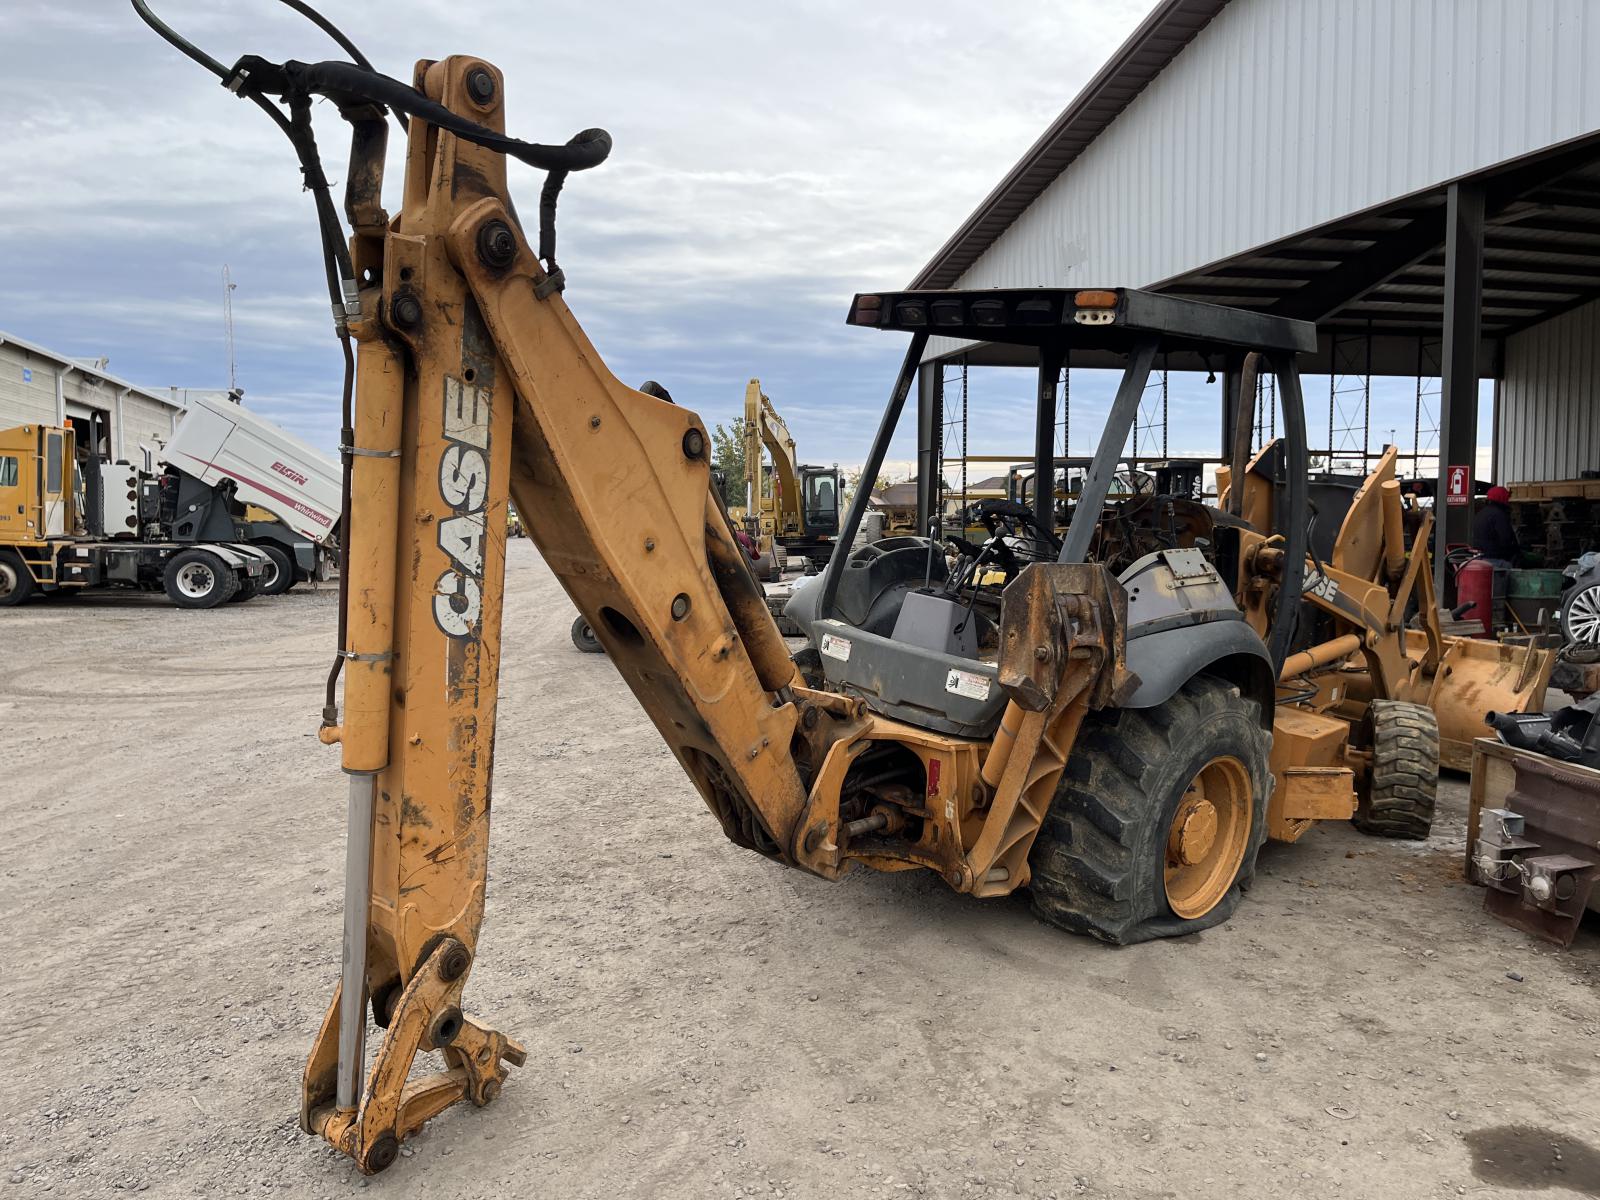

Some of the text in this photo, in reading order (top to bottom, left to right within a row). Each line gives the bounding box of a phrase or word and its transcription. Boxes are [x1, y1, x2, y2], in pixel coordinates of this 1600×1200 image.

[270, 461, 308, 486] ELGIN
[1191, 475, 1201, 500] Yale
[294, 503, 329, 525] Whirlwind
[434, 374, 490, 637] CASE
